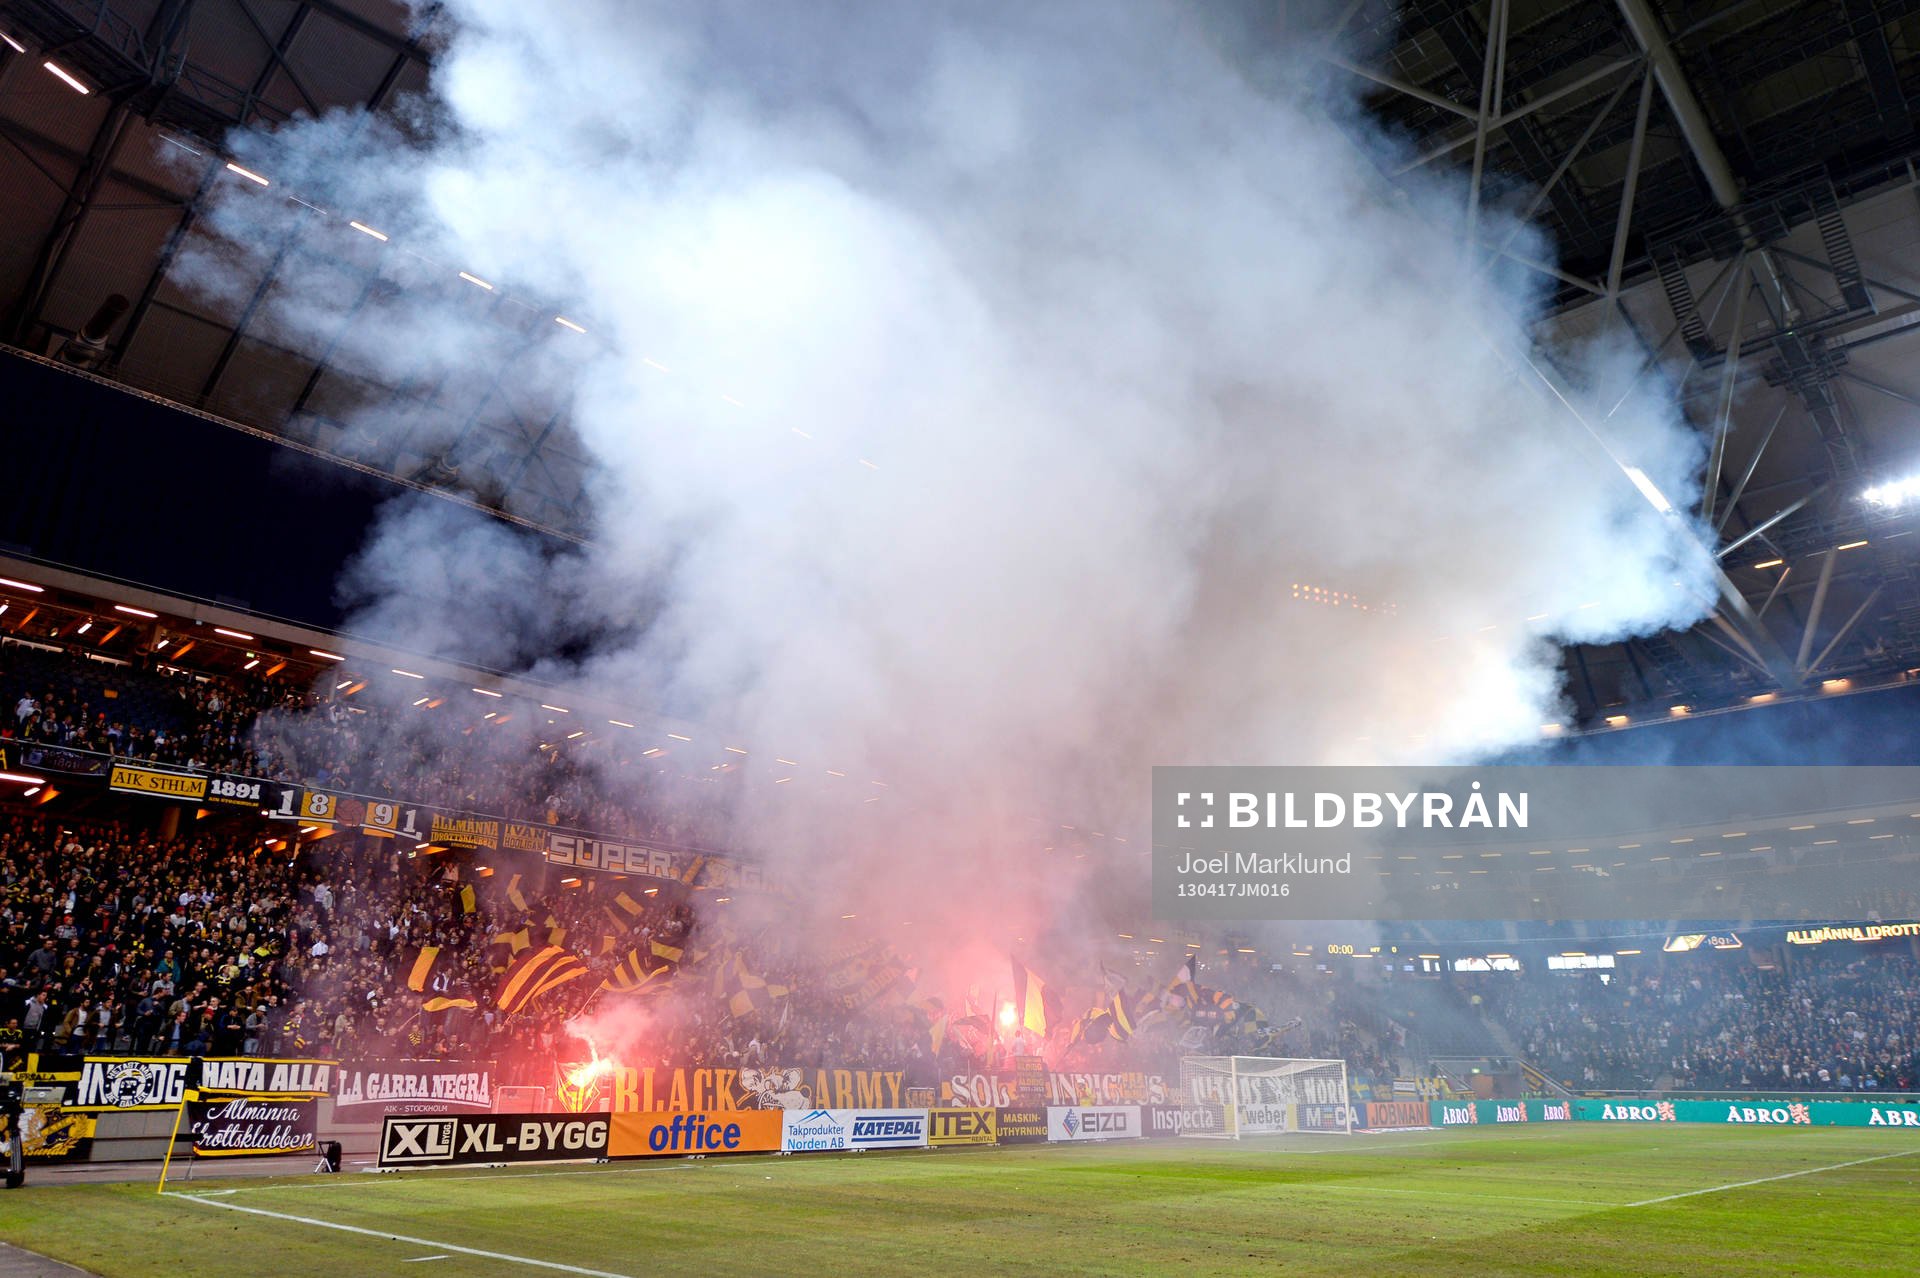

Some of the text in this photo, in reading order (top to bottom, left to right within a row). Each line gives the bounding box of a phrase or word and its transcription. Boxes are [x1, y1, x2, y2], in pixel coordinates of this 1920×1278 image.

[114, 771, 203, 794] AIK STHLM
[210, 779, 261, 800] 1891
[310, 794, 329, 815] 8
[374, 803, 393, 825] 9
[431, 813, 499, 837] ALLMÄNNA
[1786, 923, 1920, 942] ALLMÄNNA IDROTT
[1328, 944, 1354, 954] 00:00
[202, 1062, 330, 1092] HATA ALLA
[337, 1069, 490, 1101] LA GARRA NEGRA
[615, 1066, 904, 1112] BLACK ARMY
[951, 1073, 1010, 1109] SOL
[1050, 1072, 1165, 1107] INVICUS
[206, 1098, 301, 1121] Allmänna
[404, 1105, 448, 1113] STOCKHOLM
[1003, 1112, 1041, 1124] MASKIN-
[1247, 1104, 1287, 1125] weber
[1372, 1102, 1425, 1126] JOBMAN
[1443, 1105, 1469, 1124] ÅBRO
[1496, 1105, 1520, 1122] ÅBRO
[1543, 1104, 1564, 1120] ÅBRO
[1602, 1103, 1658, 1121] ÅBRO
[1727, 1105, 1790, 1123] ÅBRO
[788, 1124, 844, 1138] Takprodukter
[852, 1120, 922, 1137] KATEPAL
[930, 1111, 992, 1136] ITEX
[997, 1125, 1048, 1137] UTHYRNING
[1081, 1111, 1127, 1132] EIZO
[1152, 1107, 1214, 1134] Inspecta
[389, 1123, 450, 1156] XL
[441, 1123, 452, 1145] BYGG
[459, 1120, 608, 1154] XL-BYGG
[649, 1114, 741, 1151] office
[787, 1137, 845, 1150] Norden AB
